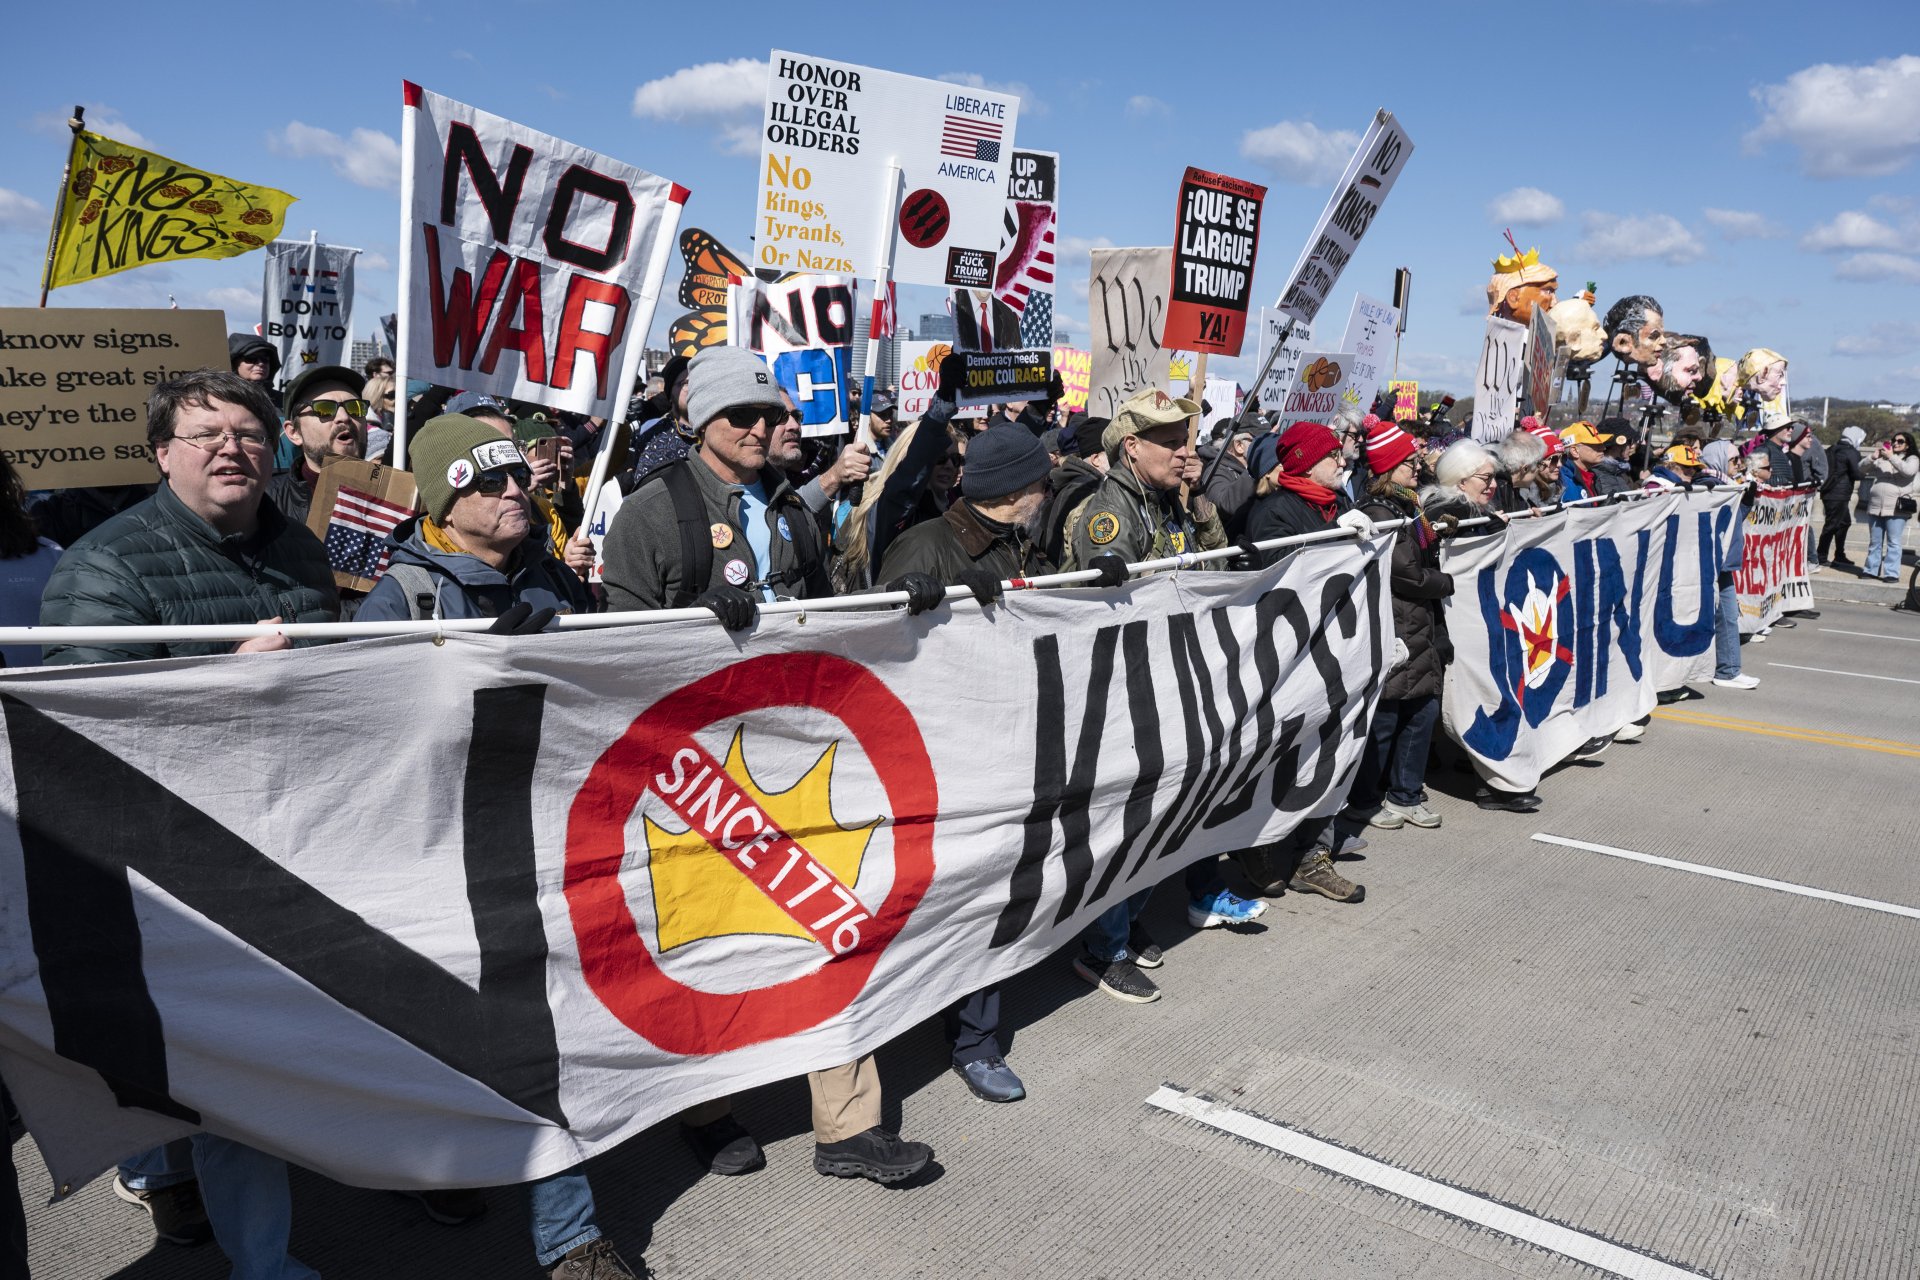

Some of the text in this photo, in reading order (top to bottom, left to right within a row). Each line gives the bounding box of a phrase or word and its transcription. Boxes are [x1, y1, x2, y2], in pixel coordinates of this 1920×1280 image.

[779, 58, 861, 92] HONOR
[788, 84, 848, 112] OVER
[945, 94, 1005, 120] LIBERATE
[770, 102, 860, 135] ILLEGAL
[767, 124, 859, 156] ORDERS
[1371, 130, 1402, 176] NO
[766, 153, 812, 190] No
[937, 162, 996, 184] AMERICA
[1016, 158, 1037, 177] UP
[105, 157, 212, 213] NO
[441, 120, 635, 274] NO
[1009, 178, 1043, 199] ICA!
[766, 192, 828, 221] Kings,
[1186, 188, 1257, 232] ¡QUE SE
[1331, 183, 1378, 241] KINGS
[91, 208, 229, 276] KINGS
[764, 216, 845, 247] Tyrants,
[761, 245, 856, 274] Or Nazis.
[1181, 224, 1253, 268] LARGUE
[954, 265, 988, 277] TRUMP
[960, 256, 985, 267] FUCK
[1298, 260, 1317, 281] NO
[289, 267, 339, 294] WE
[1184, 261, 1246, 300] TRUMP
[281, 299, 339, 316] DON'T
[423, 221, 631, 400] WAR
[698, 289, 728, 305] PROT
[268, 322, 347, 340] BOW TO
[749, 284, 853, 352] NO
[1199, 311, 1230, 342] YA!
[94, 327, 180, 355] signs.
[1296, 325, 1311, 341] make
[967, 352, 1039, 368] Democracy needs
[56, 366, 136, 392] great
[966, 366, 1046, 387] OUR COURAGE
[1269, 367, 1286, 385] orgot
[1264, 387, 1287, 402] CAN'T
[1284, 391, 1337, 413] CONGRESS
[87, 402, 137, 424] the
[370, 463, 382, 481] Tev
[989, 559, 1382, 949] KINGS!
[655, 747, 869, 955] SINCE 1776
